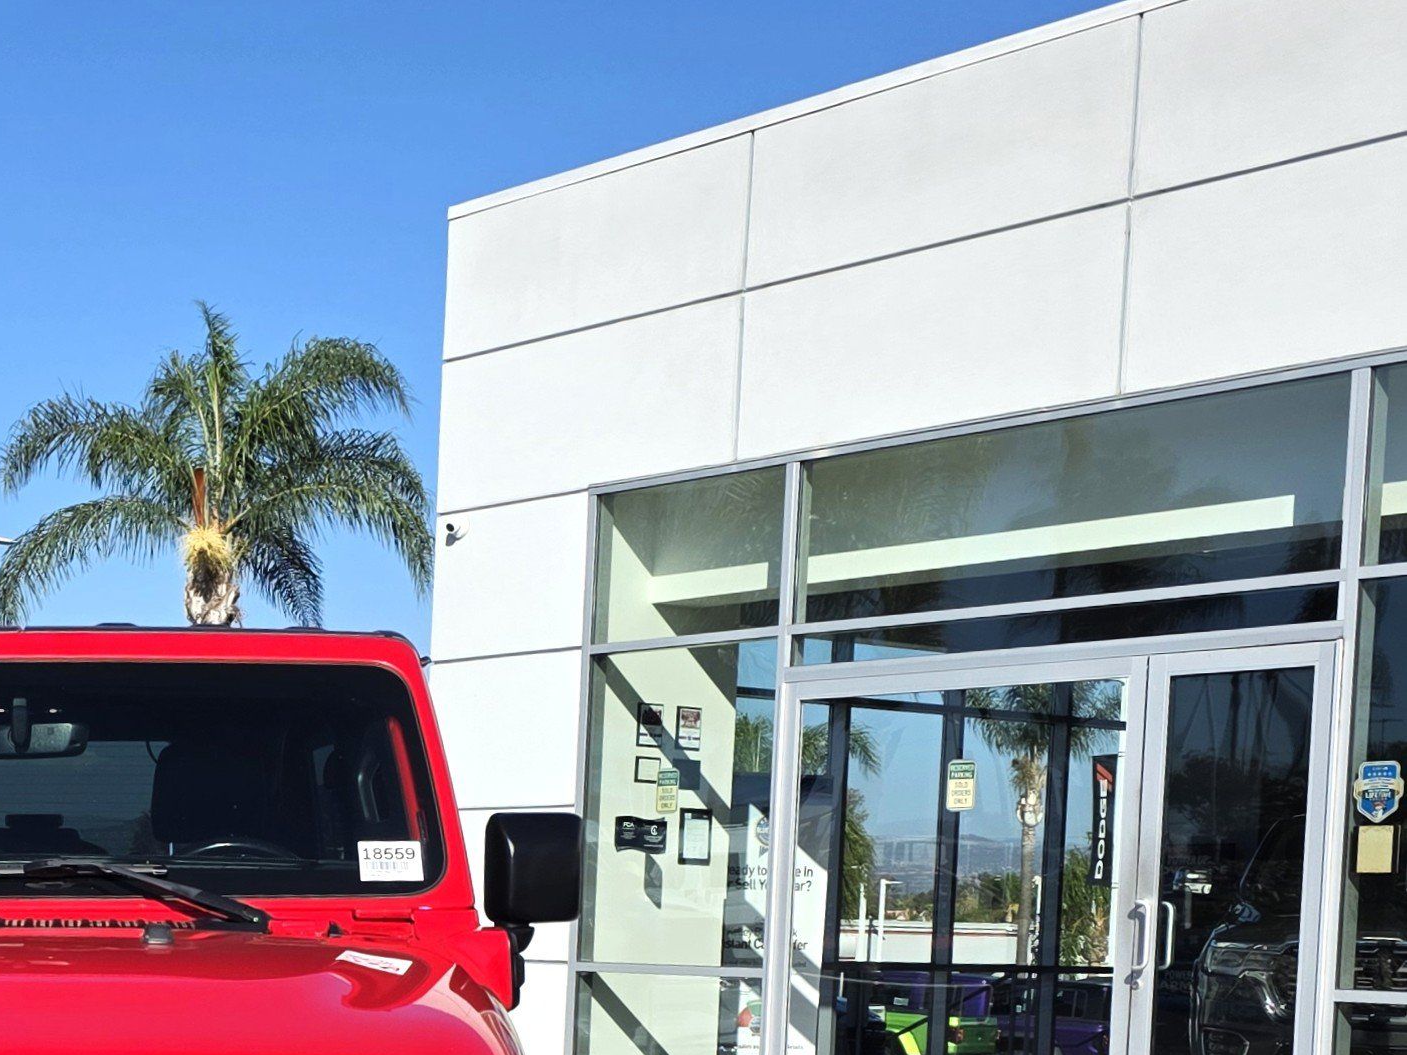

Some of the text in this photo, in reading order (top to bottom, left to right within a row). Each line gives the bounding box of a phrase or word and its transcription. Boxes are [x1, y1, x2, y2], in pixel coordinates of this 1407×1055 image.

[1094, 779, 1108, 880] DODGE
[363, 847, 415, 860] 18559
[728, 865, 755, 877] eady
[794, 880, 812, 892] ar?
